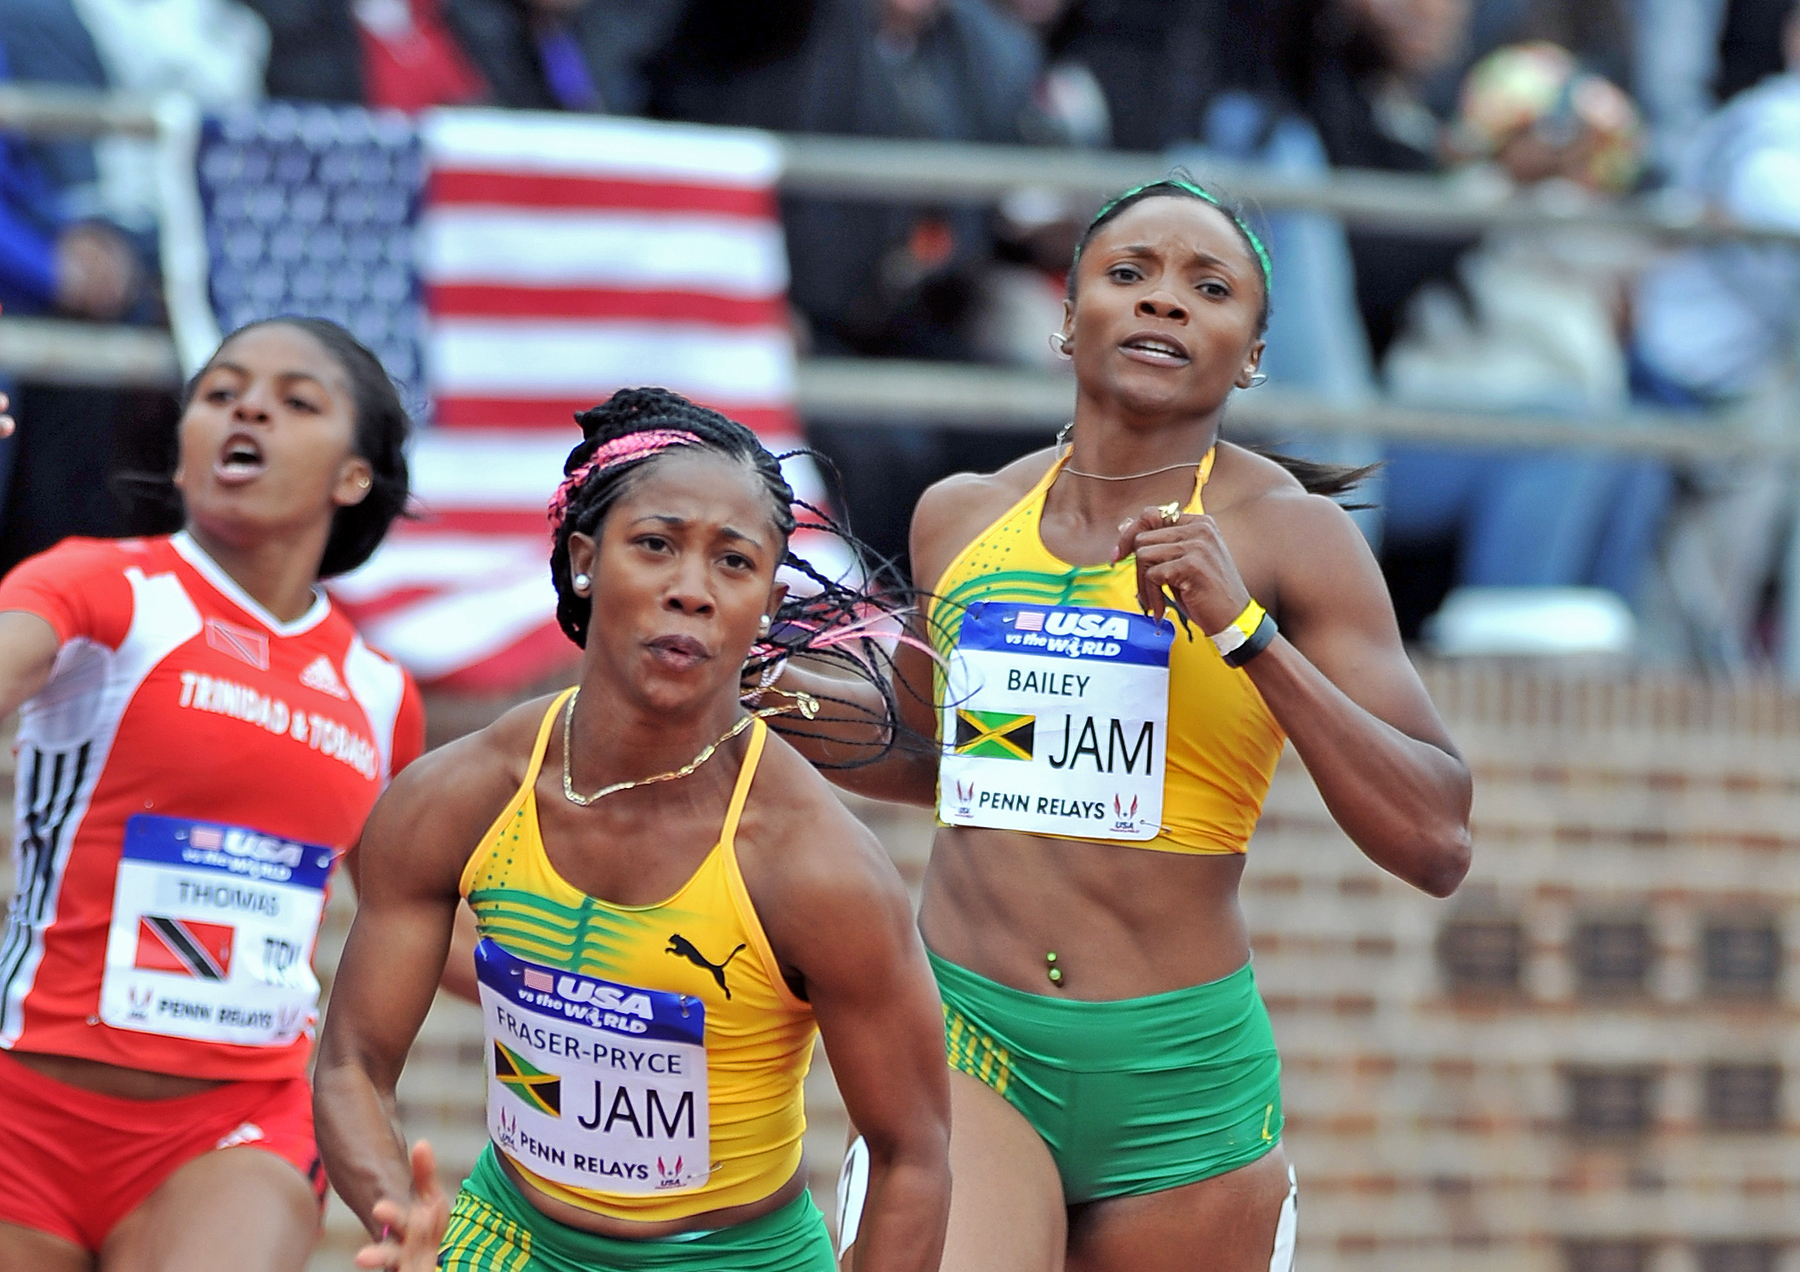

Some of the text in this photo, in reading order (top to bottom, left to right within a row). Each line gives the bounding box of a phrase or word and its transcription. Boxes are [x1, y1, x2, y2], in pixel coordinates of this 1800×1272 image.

[1004, 633, 1022, 645] vs
[1022, 633, 1048, 646] the
[1045, 612, 1129, 640] USA
[1007, 668, 1091, 698] BAILEY
[178, 671, 290, 735] TRINIDAD
[289, 710, 309, 743] &
[1048, 714, 1154, 776] JAM
[979, 791, 1105, 820] PENN RELAYS
[1115, 820, 1134, 830] USA
[222, 828, 304, 868] USA
[179, 881, 280, 917] THOMAS
[158, 1000, 273, 1030] PENN RELAYS
[517, 989, 535, 1003] vs
[535, 994, 563, 1011] the
[557, 976, 654, 1021] USA
[495, 1006, 683, 1075] FRASER-PRYCE
[577, 1080, 695, 1139] JAM
[520, 1131, 649, 1181] PENN RELAYS
[660, 1178, 681, 1187] USA
